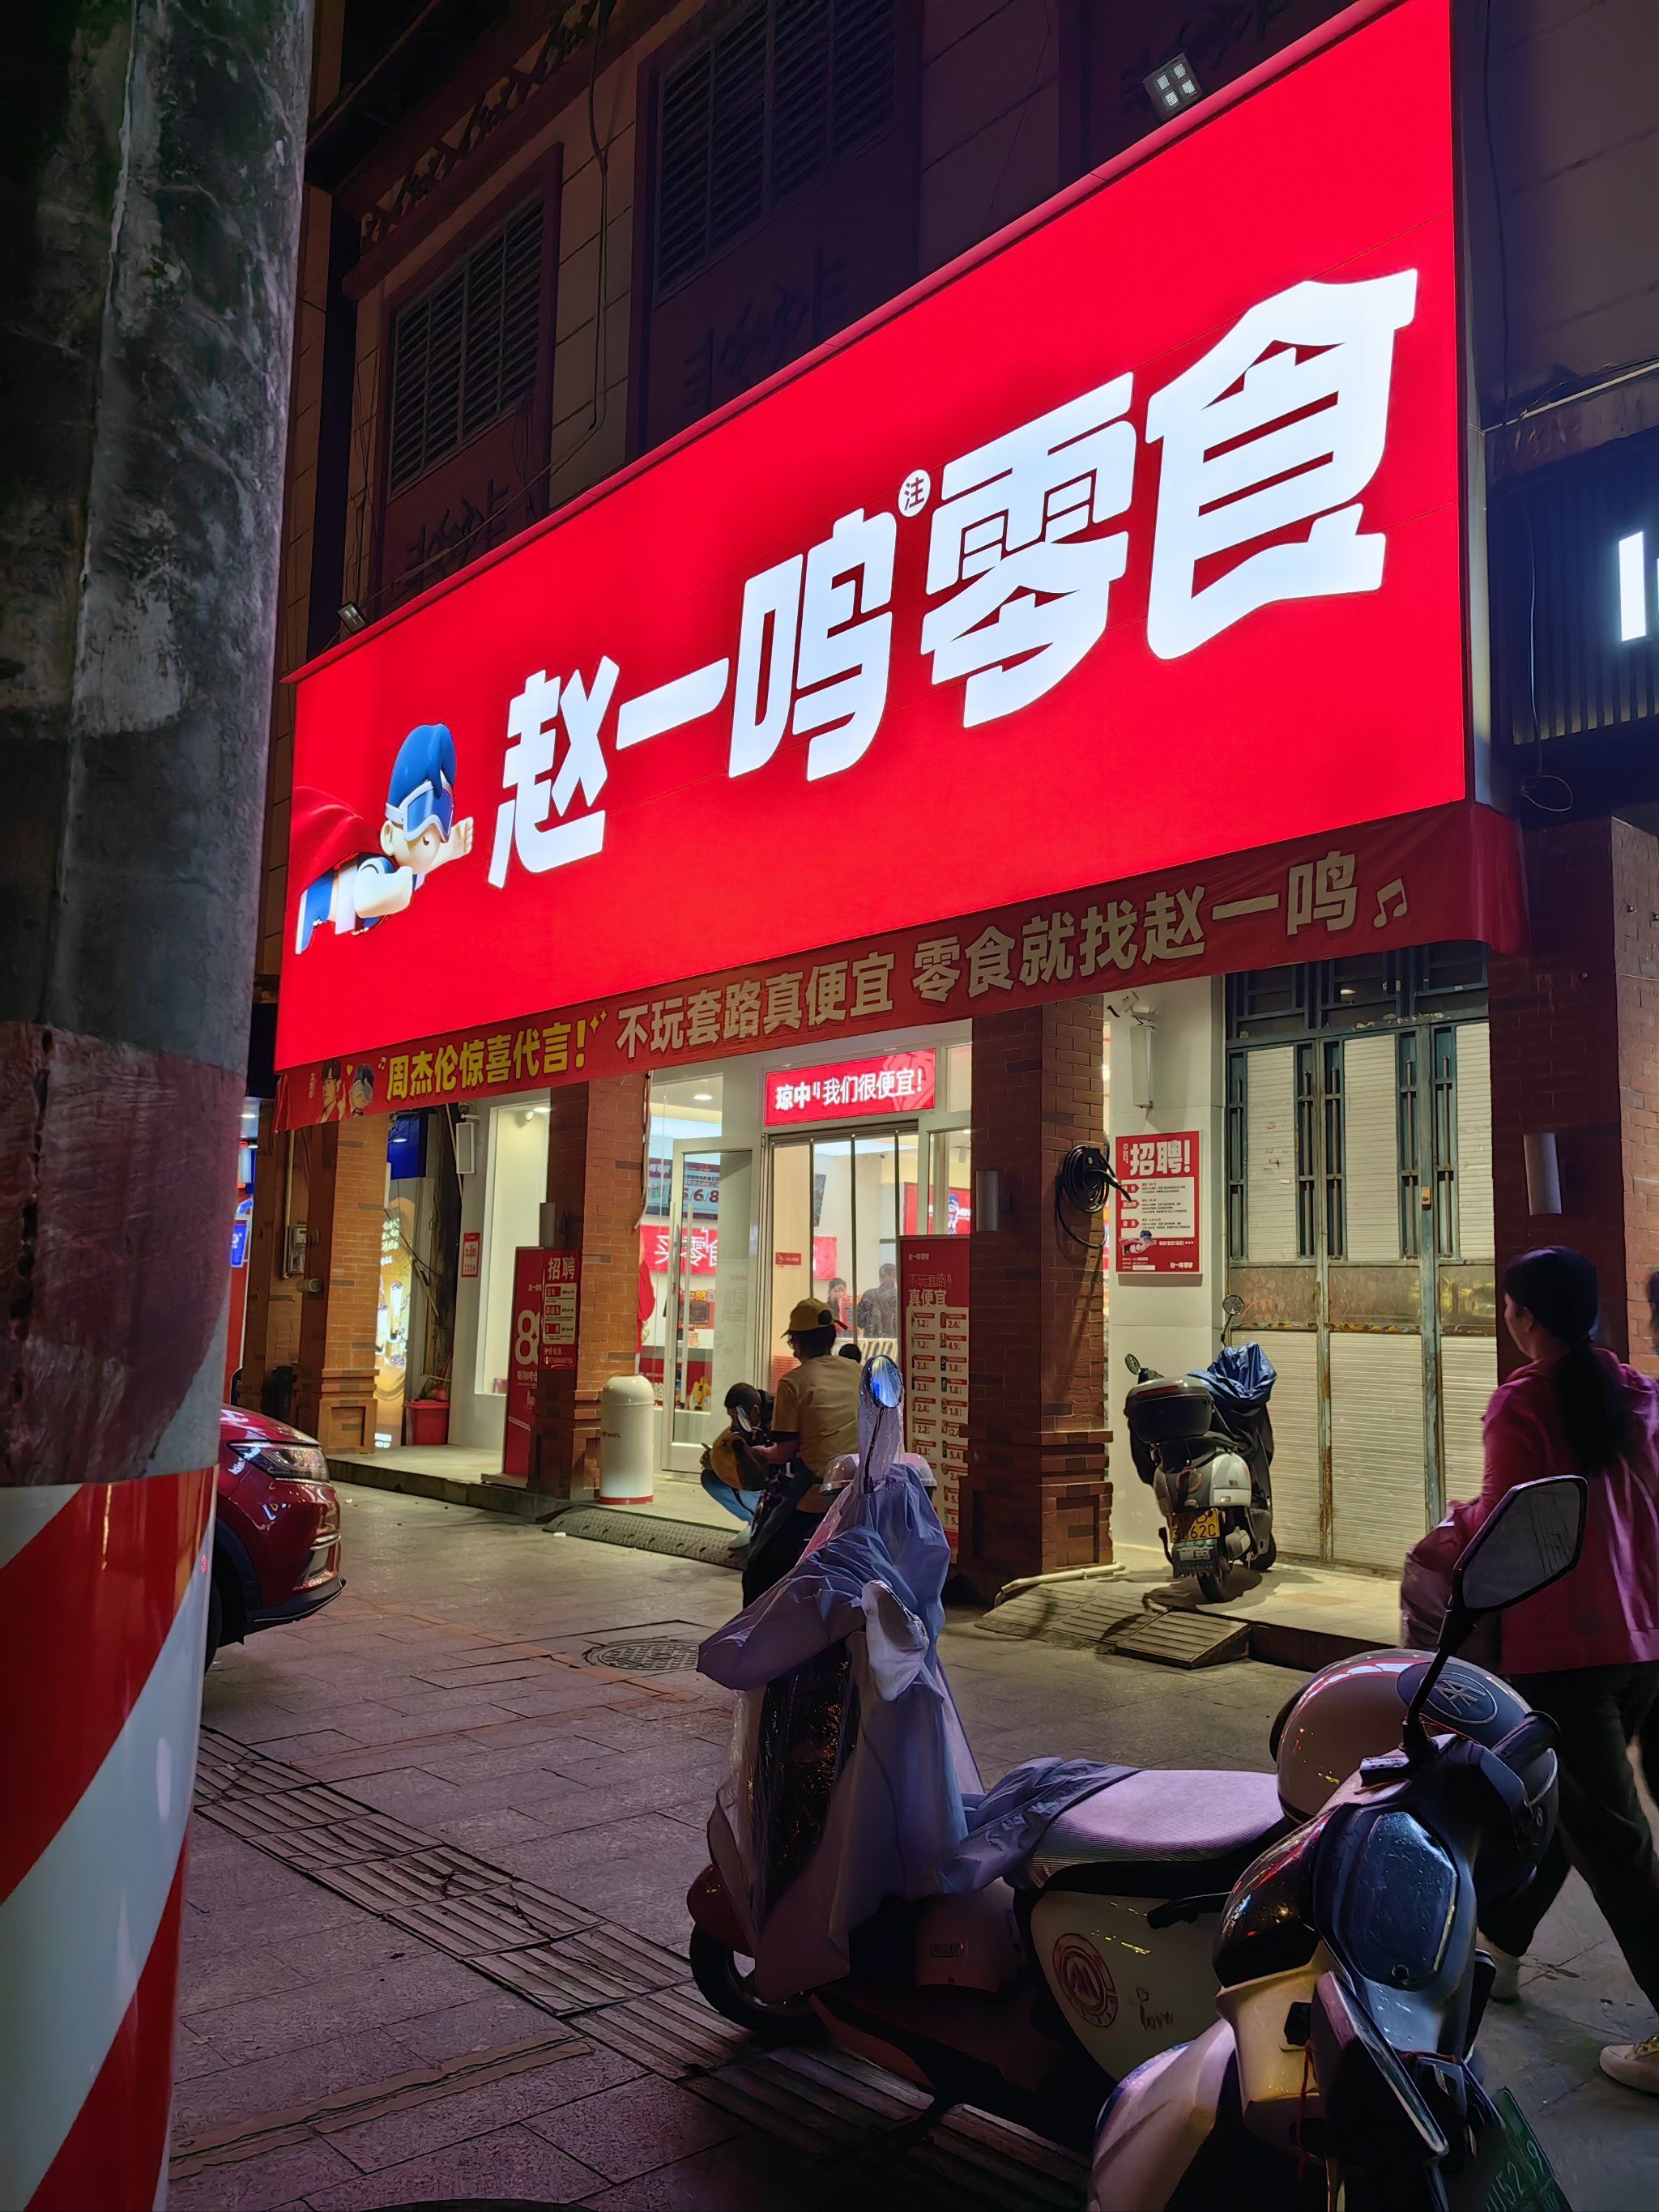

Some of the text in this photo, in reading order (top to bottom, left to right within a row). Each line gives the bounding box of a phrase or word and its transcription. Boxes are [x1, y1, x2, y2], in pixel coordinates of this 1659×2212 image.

[488, 268, 1418, 889] 赵一鸣零食
[386, 850, 1358, 1102] 周杰伦惊喜代言！ 不玩套路真便宜 零食就找赵一鸣
[1130, 1140, 1191, 1176] 招聘！
[548, 1257, 576, 1281] 招聘
[908, 1289, 947, 1306] 真便宜
[515, 1309, 540, 1365] 8
